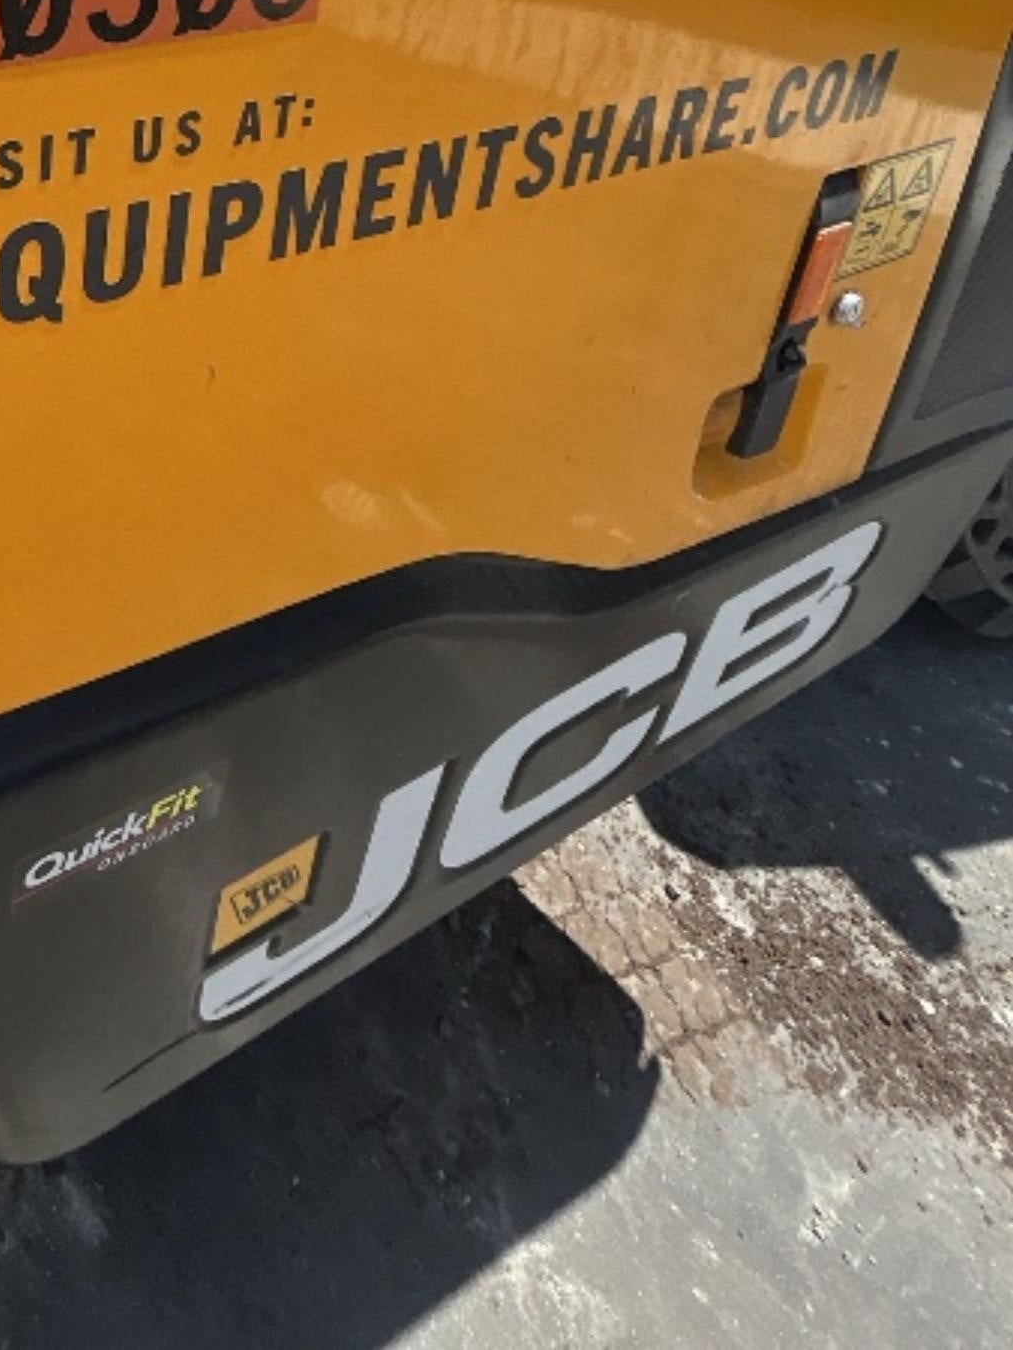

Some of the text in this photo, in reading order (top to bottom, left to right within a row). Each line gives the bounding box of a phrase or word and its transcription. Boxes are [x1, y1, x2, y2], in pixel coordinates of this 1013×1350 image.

[132, 110, 203, 164] US
[233, 94, 316, 146] AT:
[199, 521, 882, 1022] JCB
[24, 784, 204, 890] QuickFit
